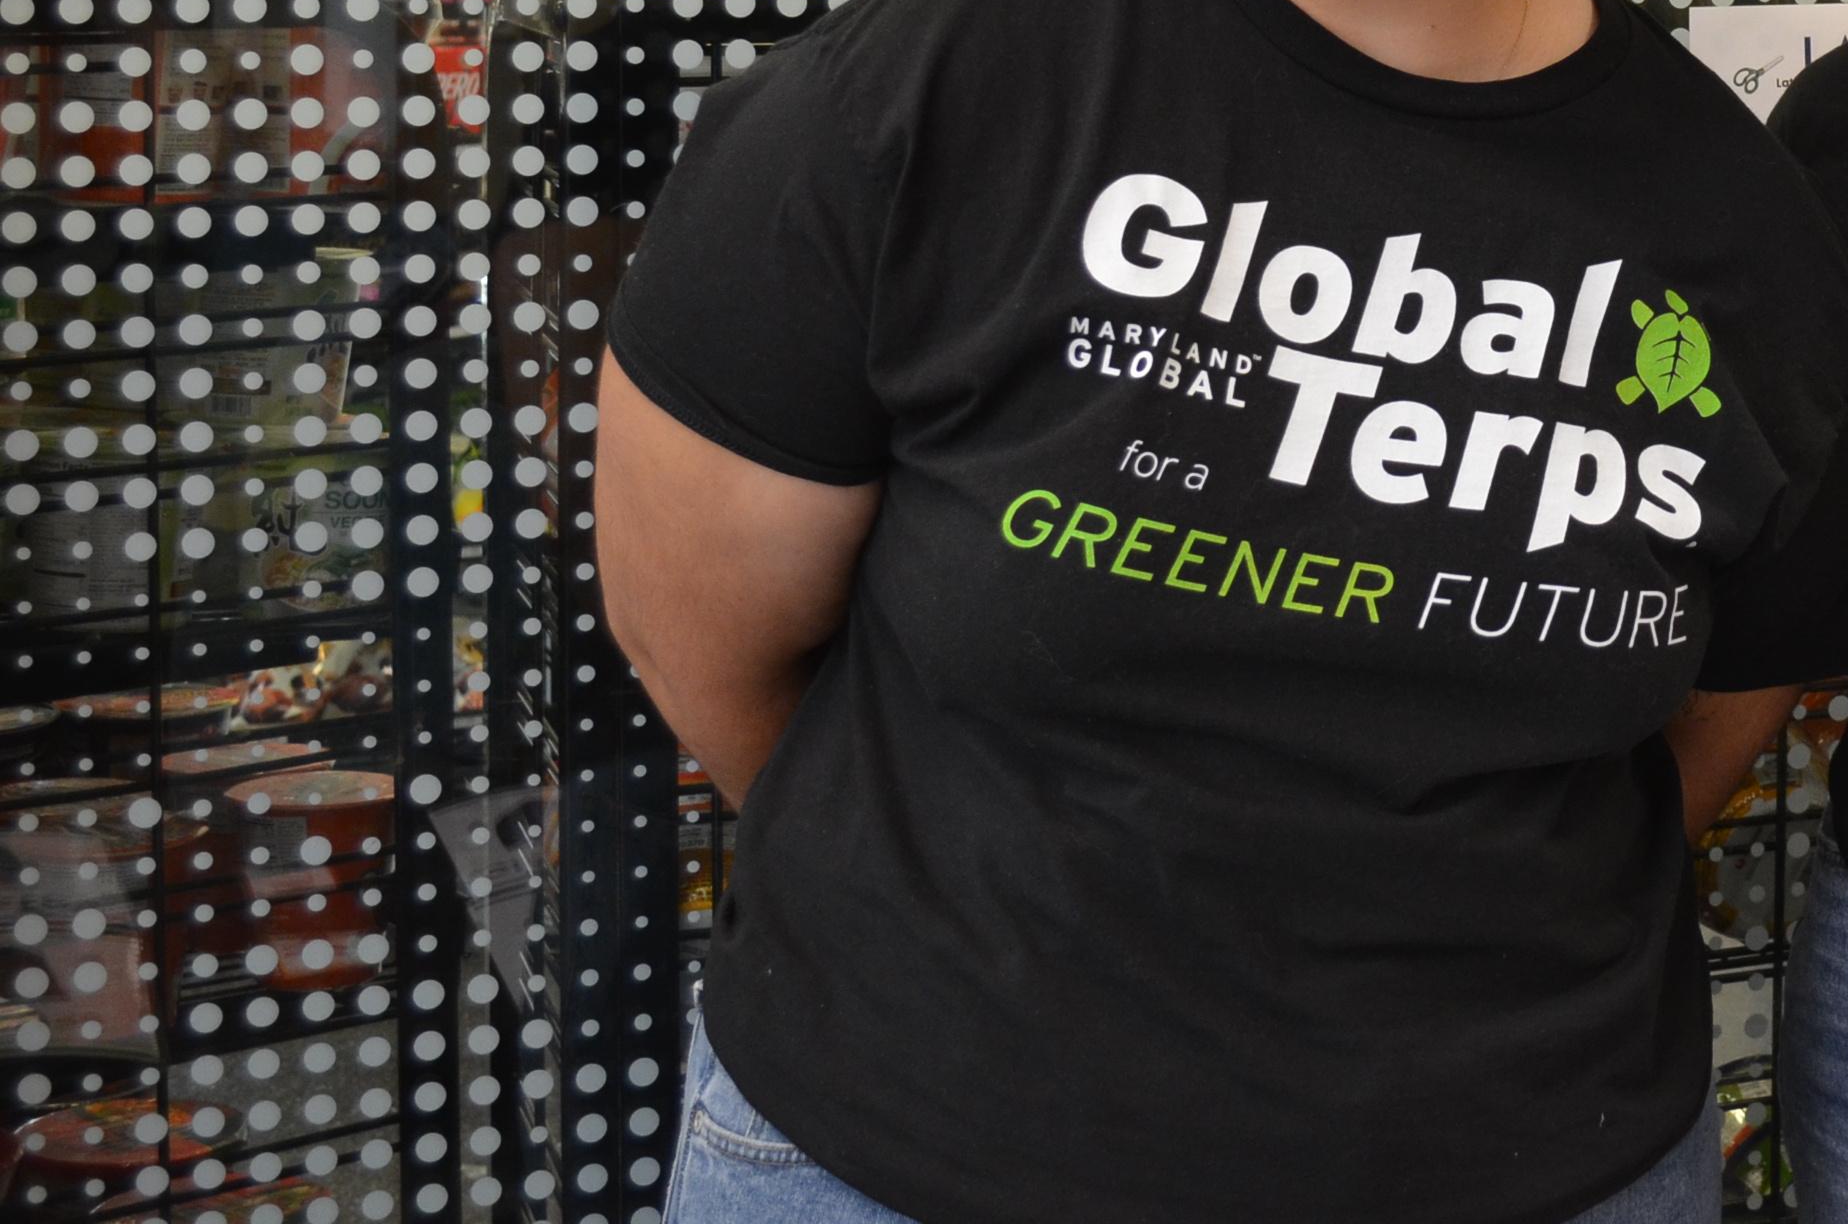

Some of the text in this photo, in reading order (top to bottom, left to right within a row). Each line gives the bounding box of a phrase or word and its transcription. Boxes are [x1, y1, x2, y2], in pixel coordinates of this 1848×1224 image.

[1082, 173, 1622, 388] Global
[1067, 337, 1246, 408] GLOBAL
[1268, 344, 1706, 553] Terps
[1117, 439, 1210, 491] for a
[1001, 489, 1690, 649] GREENER FUTURE
